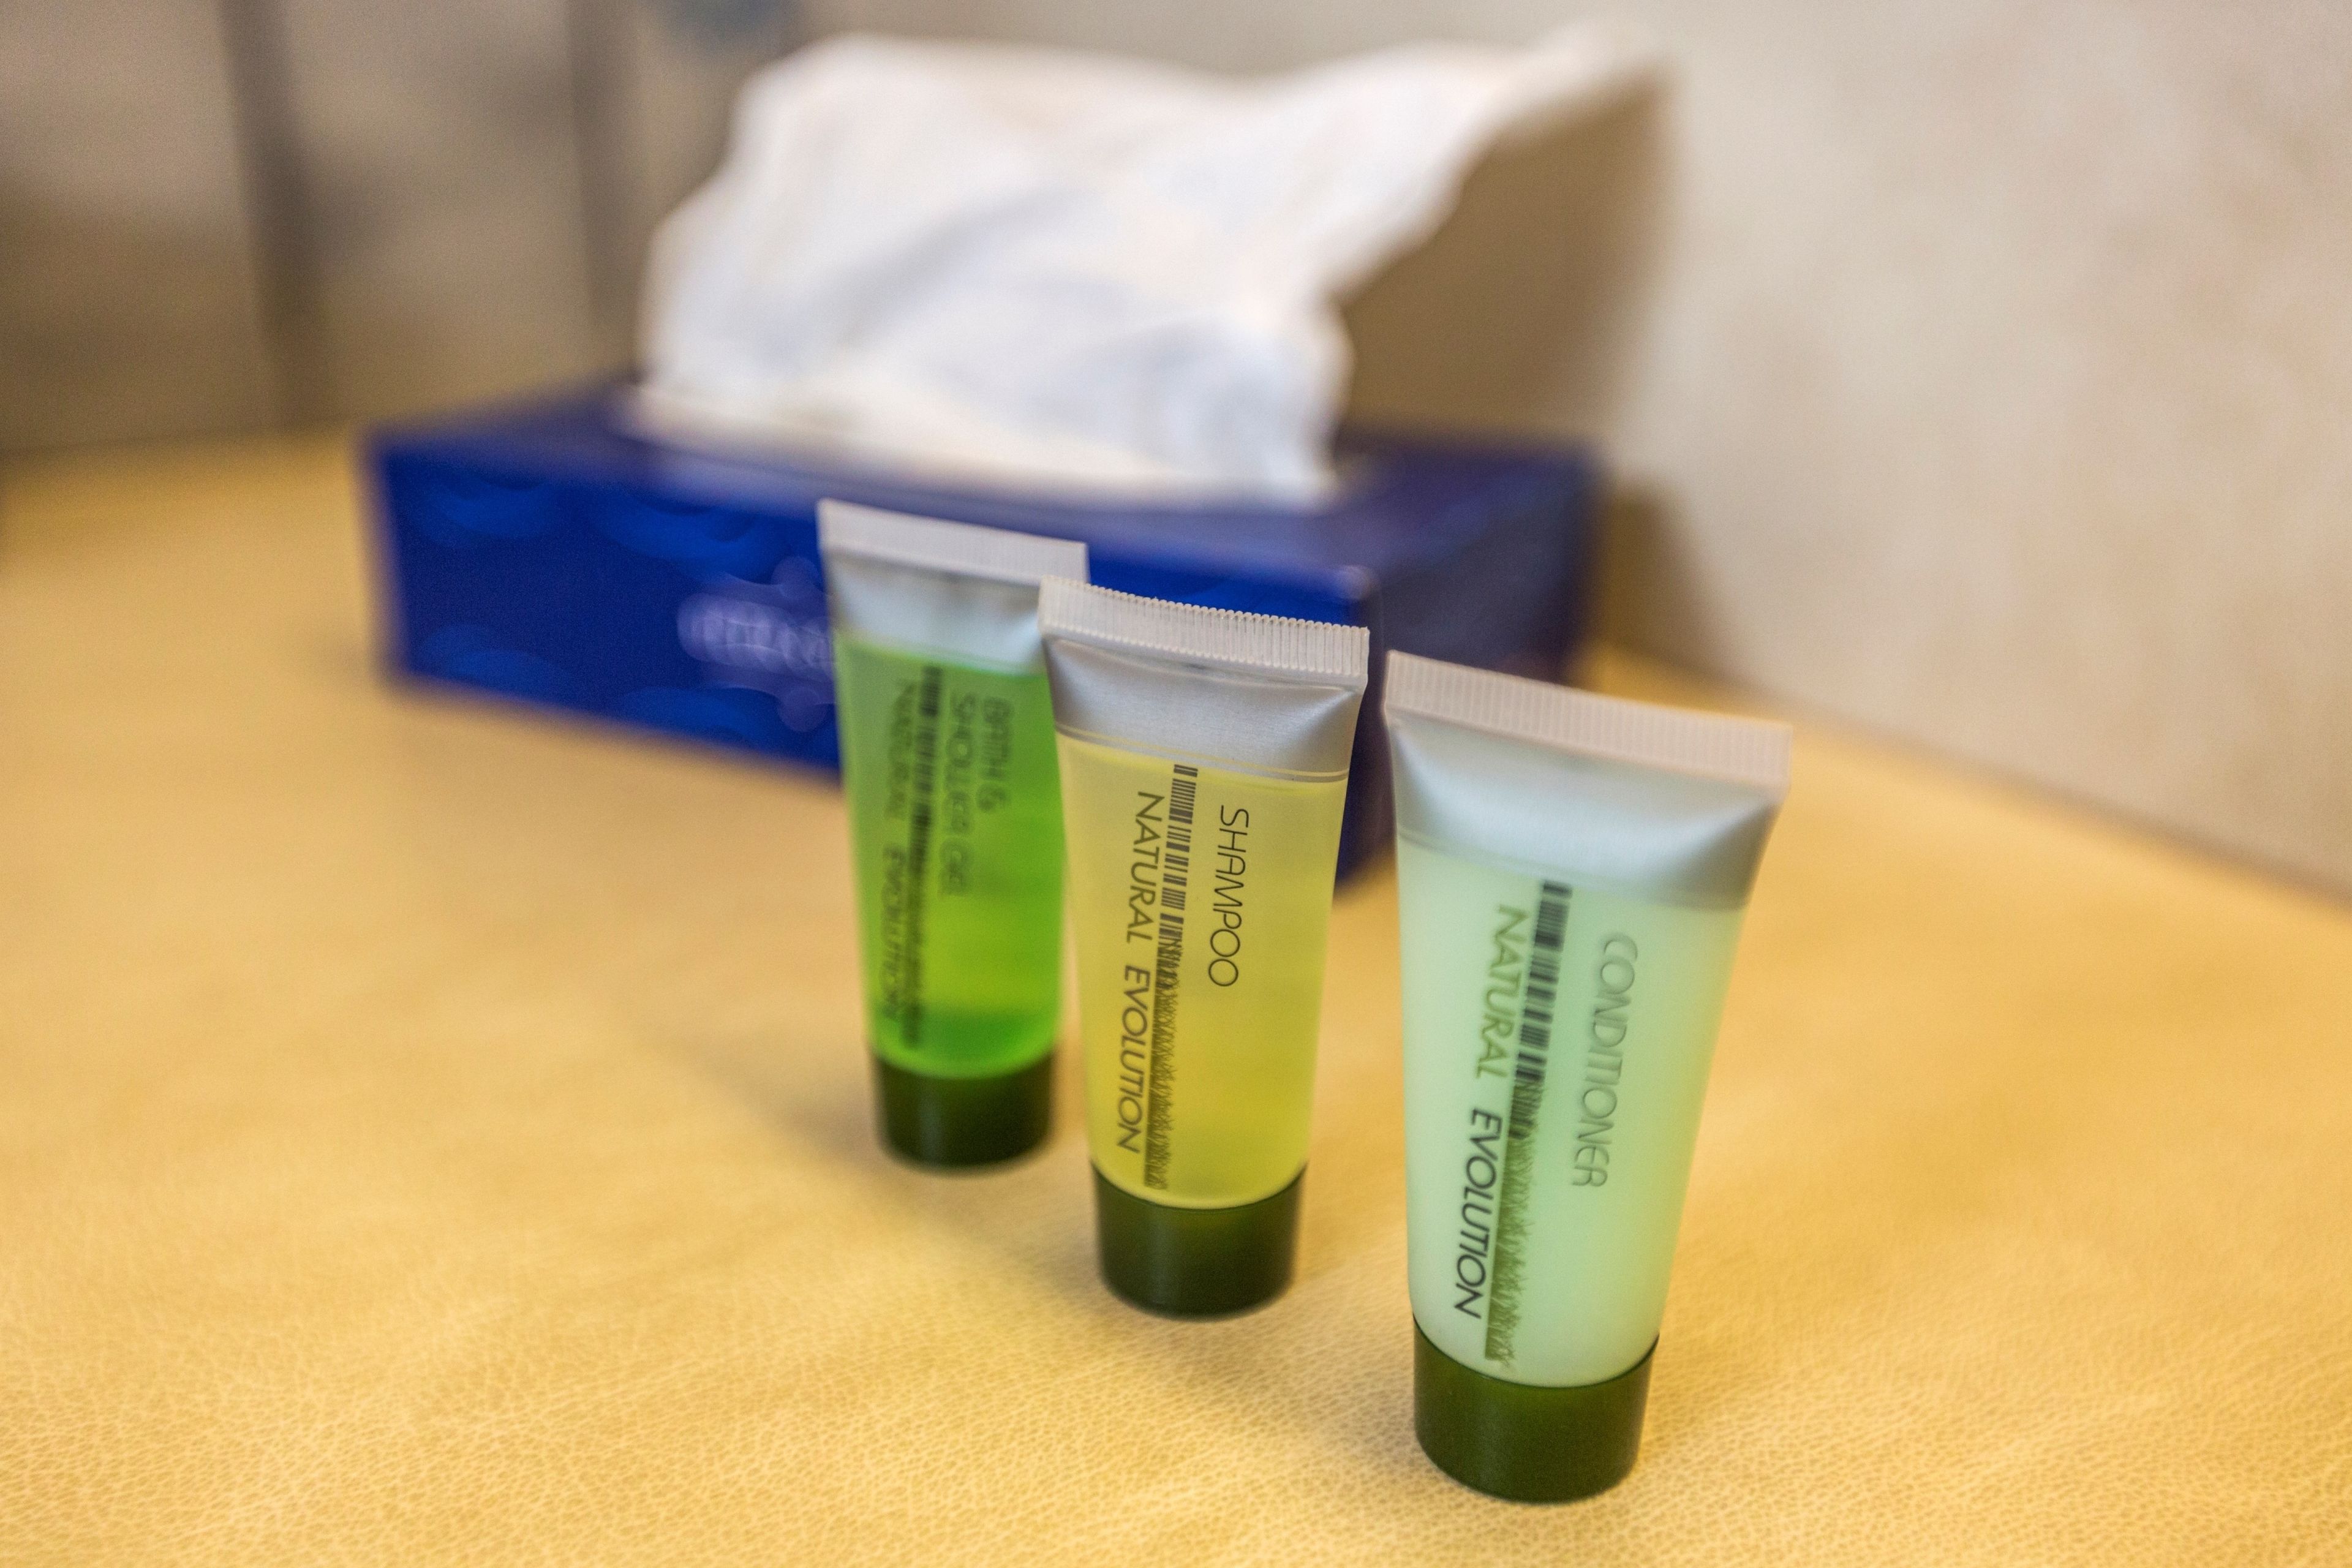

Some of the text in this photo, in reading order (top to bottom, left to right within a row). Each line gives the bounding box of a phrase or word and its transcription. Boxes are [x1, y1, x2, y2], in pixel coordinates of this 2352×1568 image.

[981, 693, 1012, 783] BATH
[880, 843, 907, 1019] EVOLUTION
[1116, 791, 1165, 1153] NATURAL EVOLUTION
[1208, 805, 1250, 987] SHAMPOO
[1454, 903, 1530, 1319] NATURAL EVOLUTION
[1572, 932, 1638, 1188] CONDITIONER
